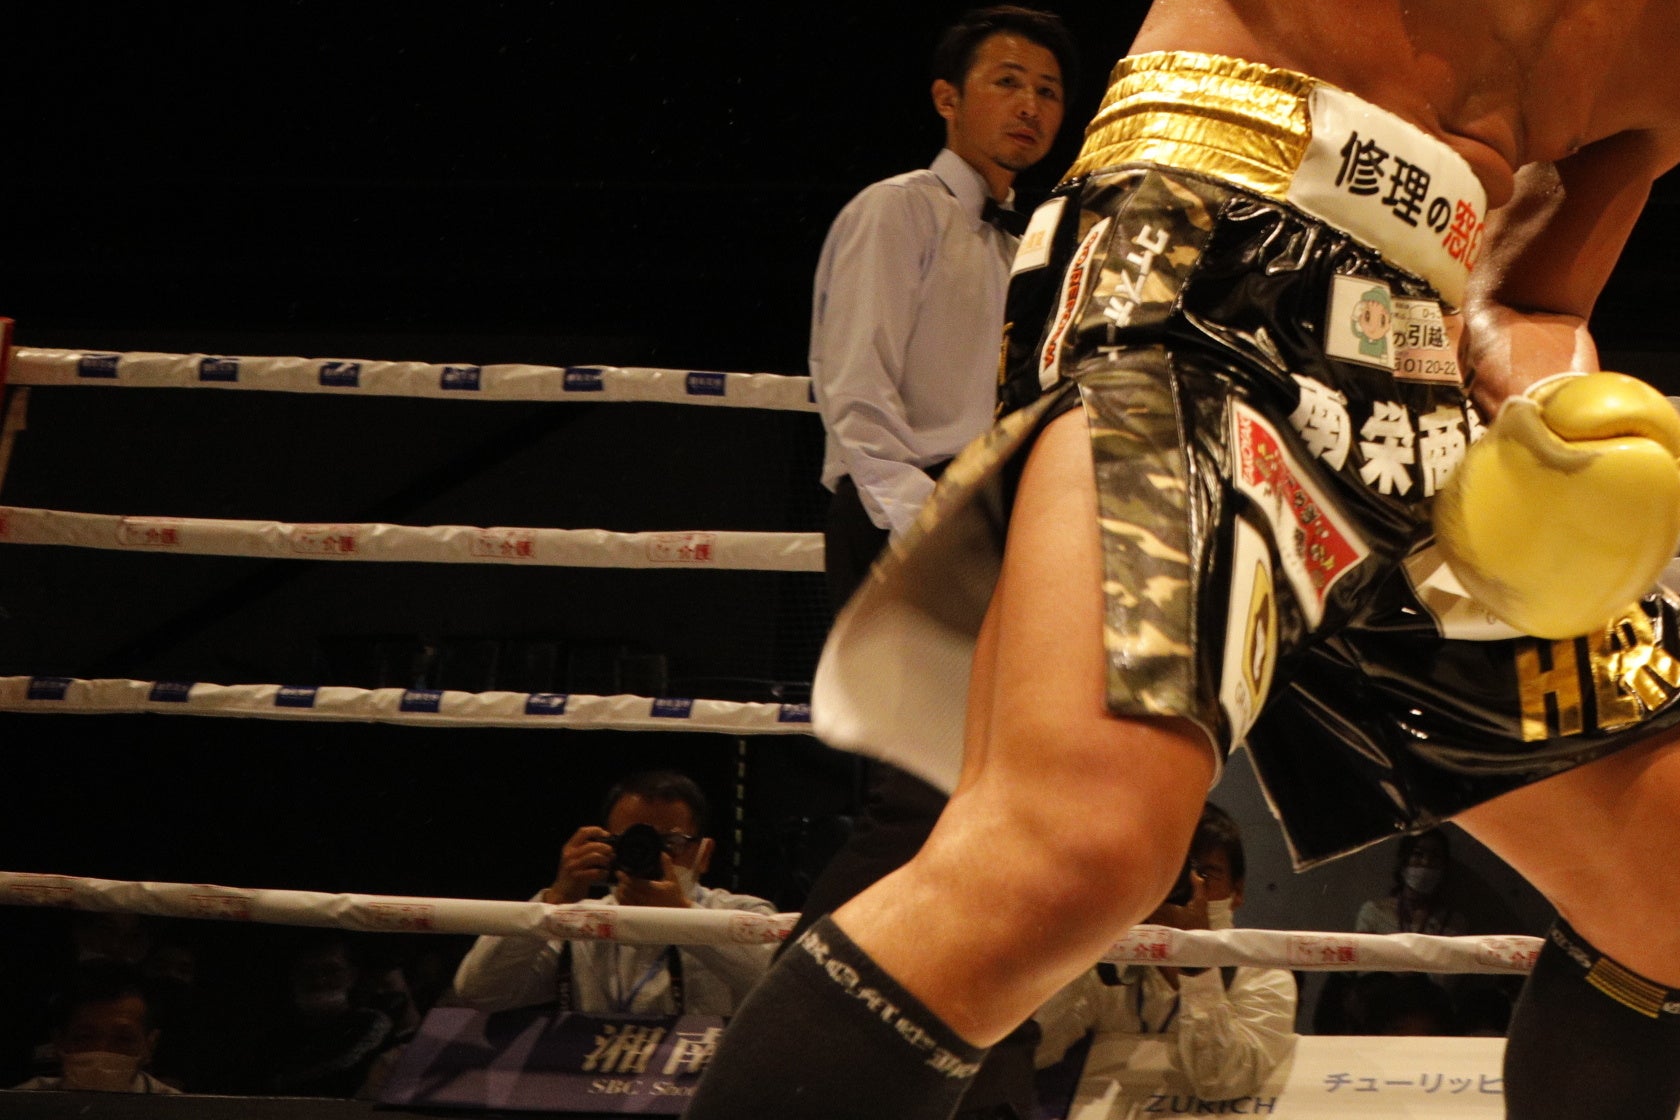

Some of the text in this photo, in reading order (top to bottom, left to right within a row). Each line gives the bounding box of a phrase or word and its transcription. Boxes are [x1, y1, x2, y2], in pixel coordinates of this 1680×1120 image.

[1288, 373, 1487, 497] 南栄商
[1323, 1071, 1504, 1095] チューリッヒ
